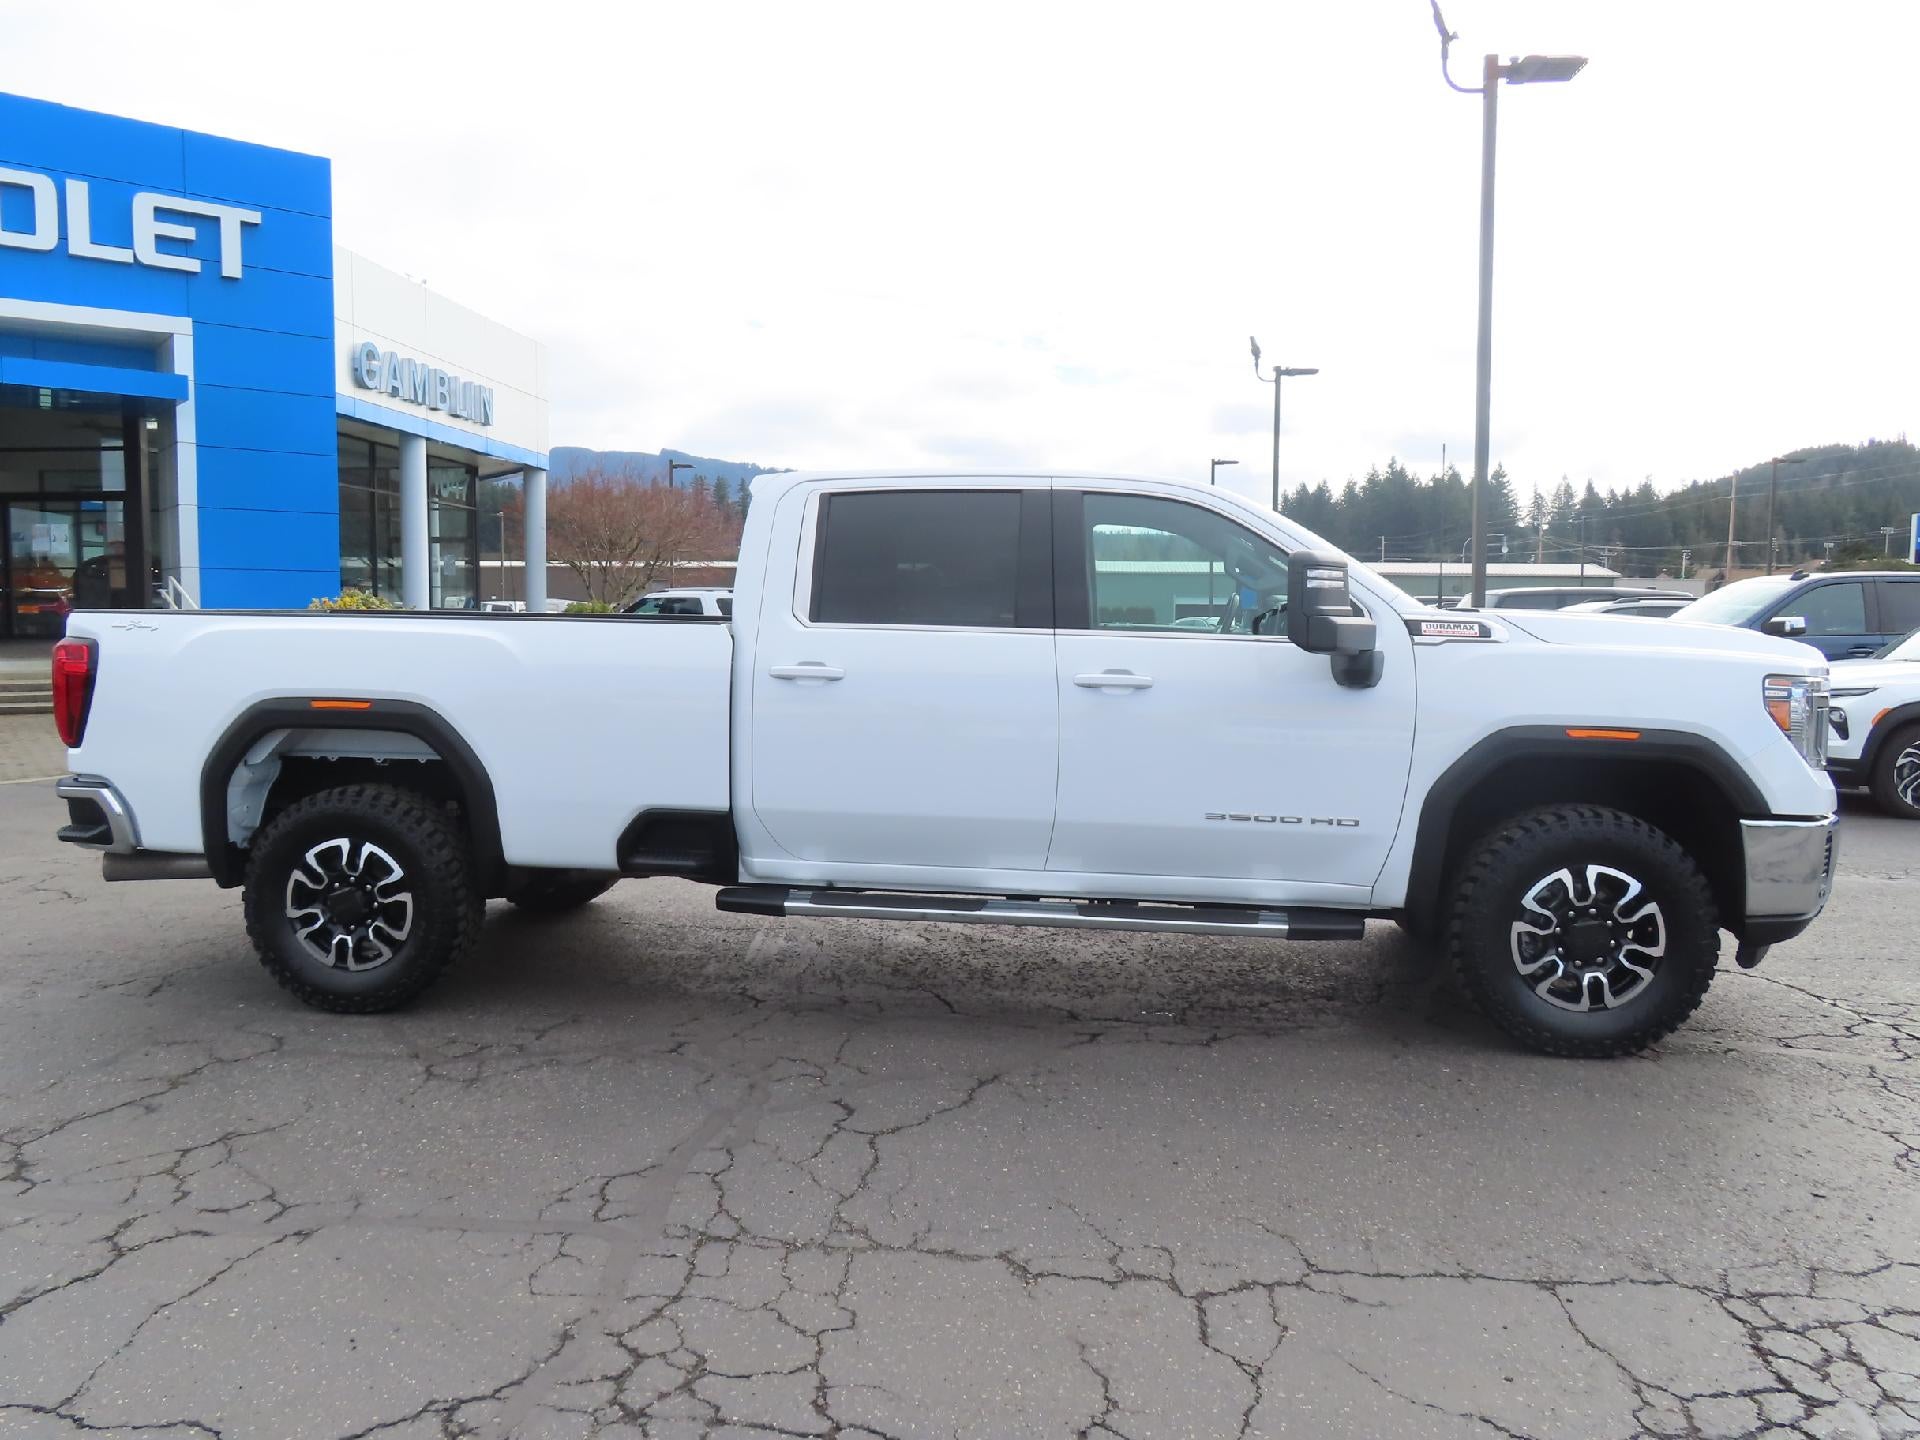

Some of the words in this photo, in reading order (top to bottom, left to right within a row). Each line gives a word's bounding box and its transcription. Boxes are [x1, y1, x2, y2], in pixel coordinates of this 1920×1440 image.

[0, 166, 261, 279] OLET
[354, 341, 494, 426] GAMBLIN
[1425, 623, 1475, 631] DURAMAX
[1310, 816, 1360, 827] HD
